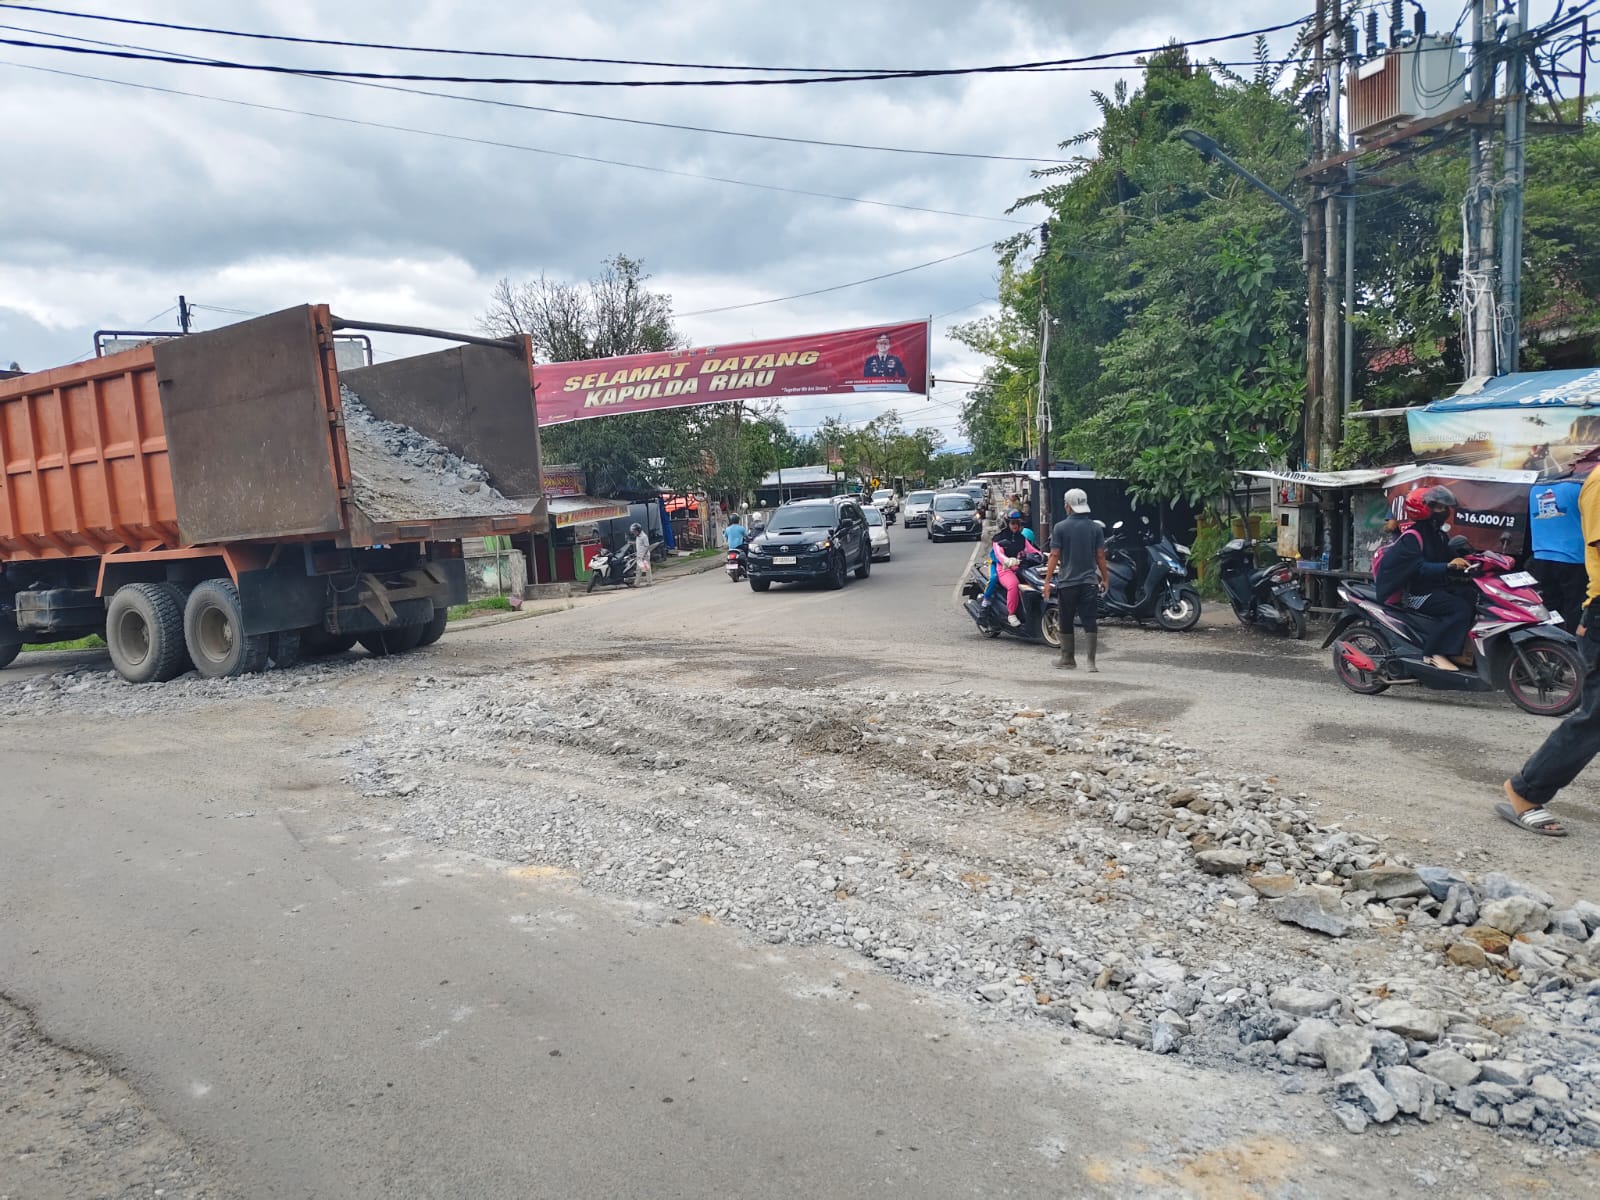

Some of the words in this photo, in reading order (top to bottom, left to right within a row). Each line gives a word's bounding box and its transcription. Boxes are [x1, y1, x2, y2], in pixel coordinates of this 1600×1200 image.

[563, 362, 690, 392] SELAMAT
[699, 350, 820, 374] DATANG
[584, 377, 698, 408] KAPOLDA
[709, 370, 776, 392] RIAU
